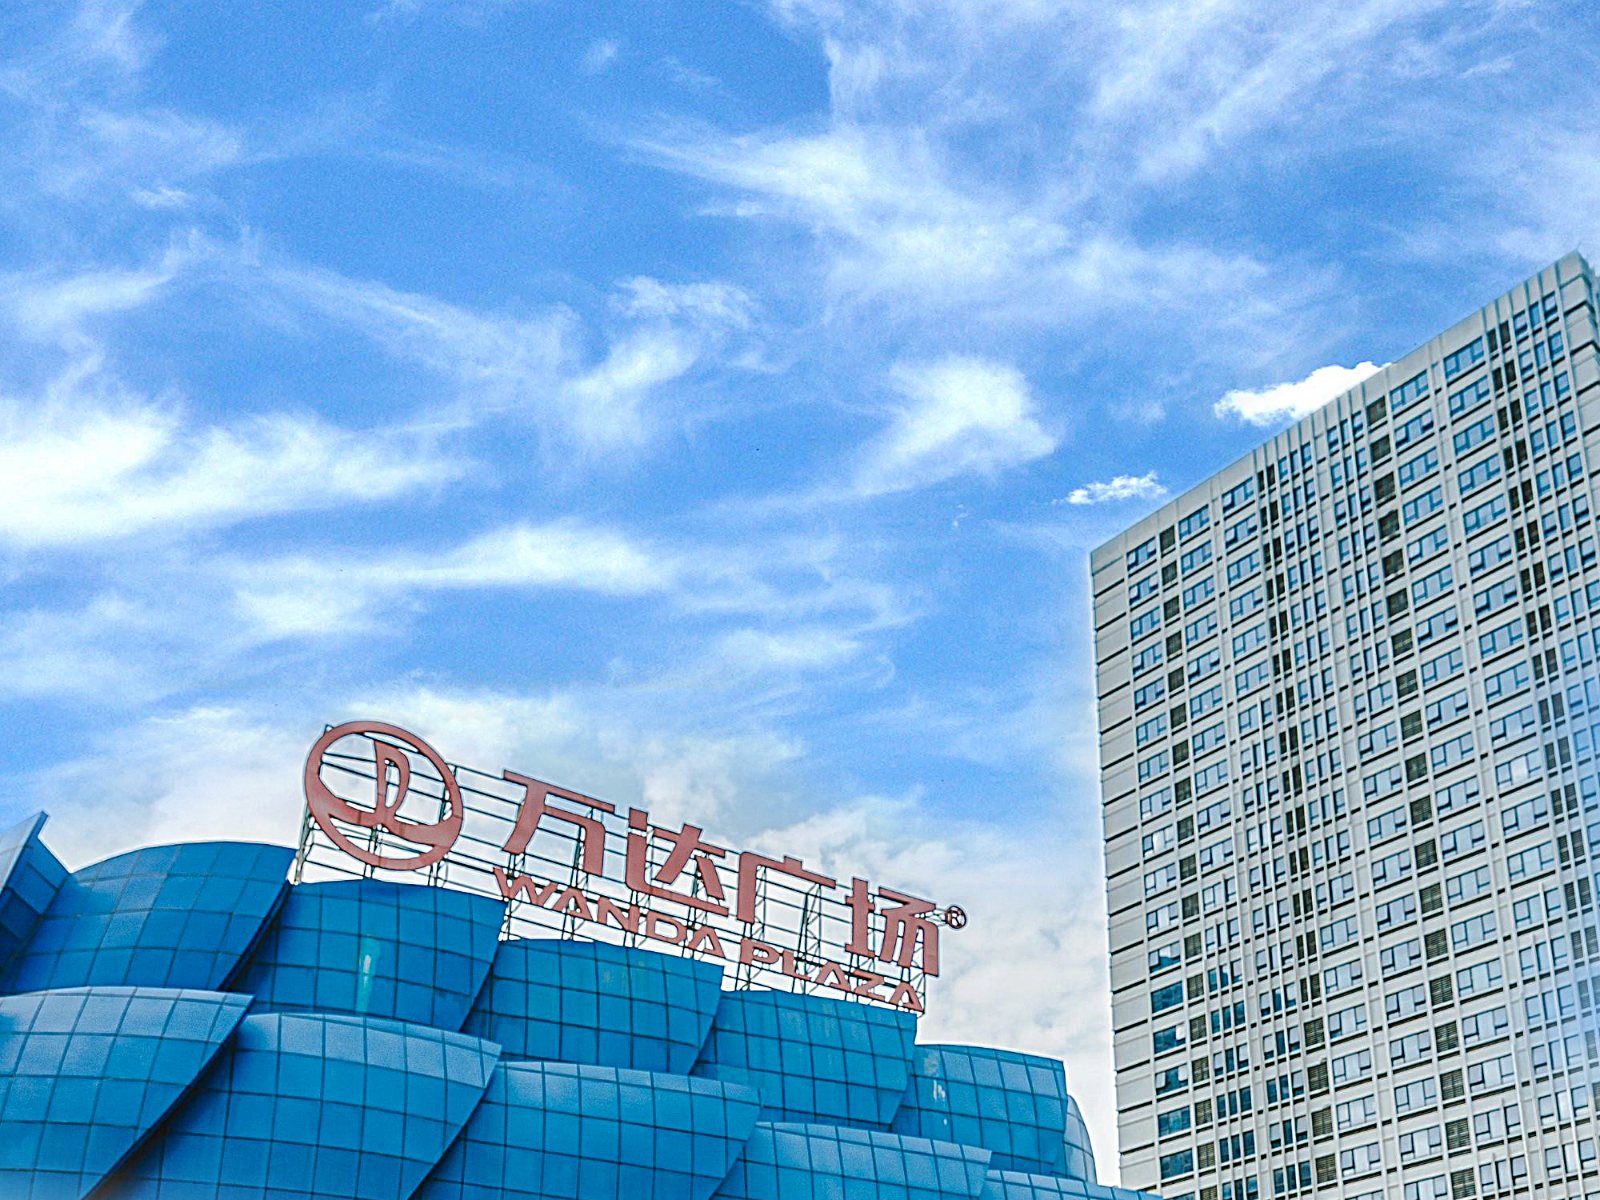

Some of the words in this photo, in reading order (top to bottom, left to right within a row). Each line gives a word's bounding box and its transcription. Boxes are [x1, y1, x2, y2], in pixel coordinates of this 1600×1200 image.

[492, 866, 726, 959] WANDA
[739, 936, 925, 1013] PLAZA
[503, 769, 939, 977] 万达广场
